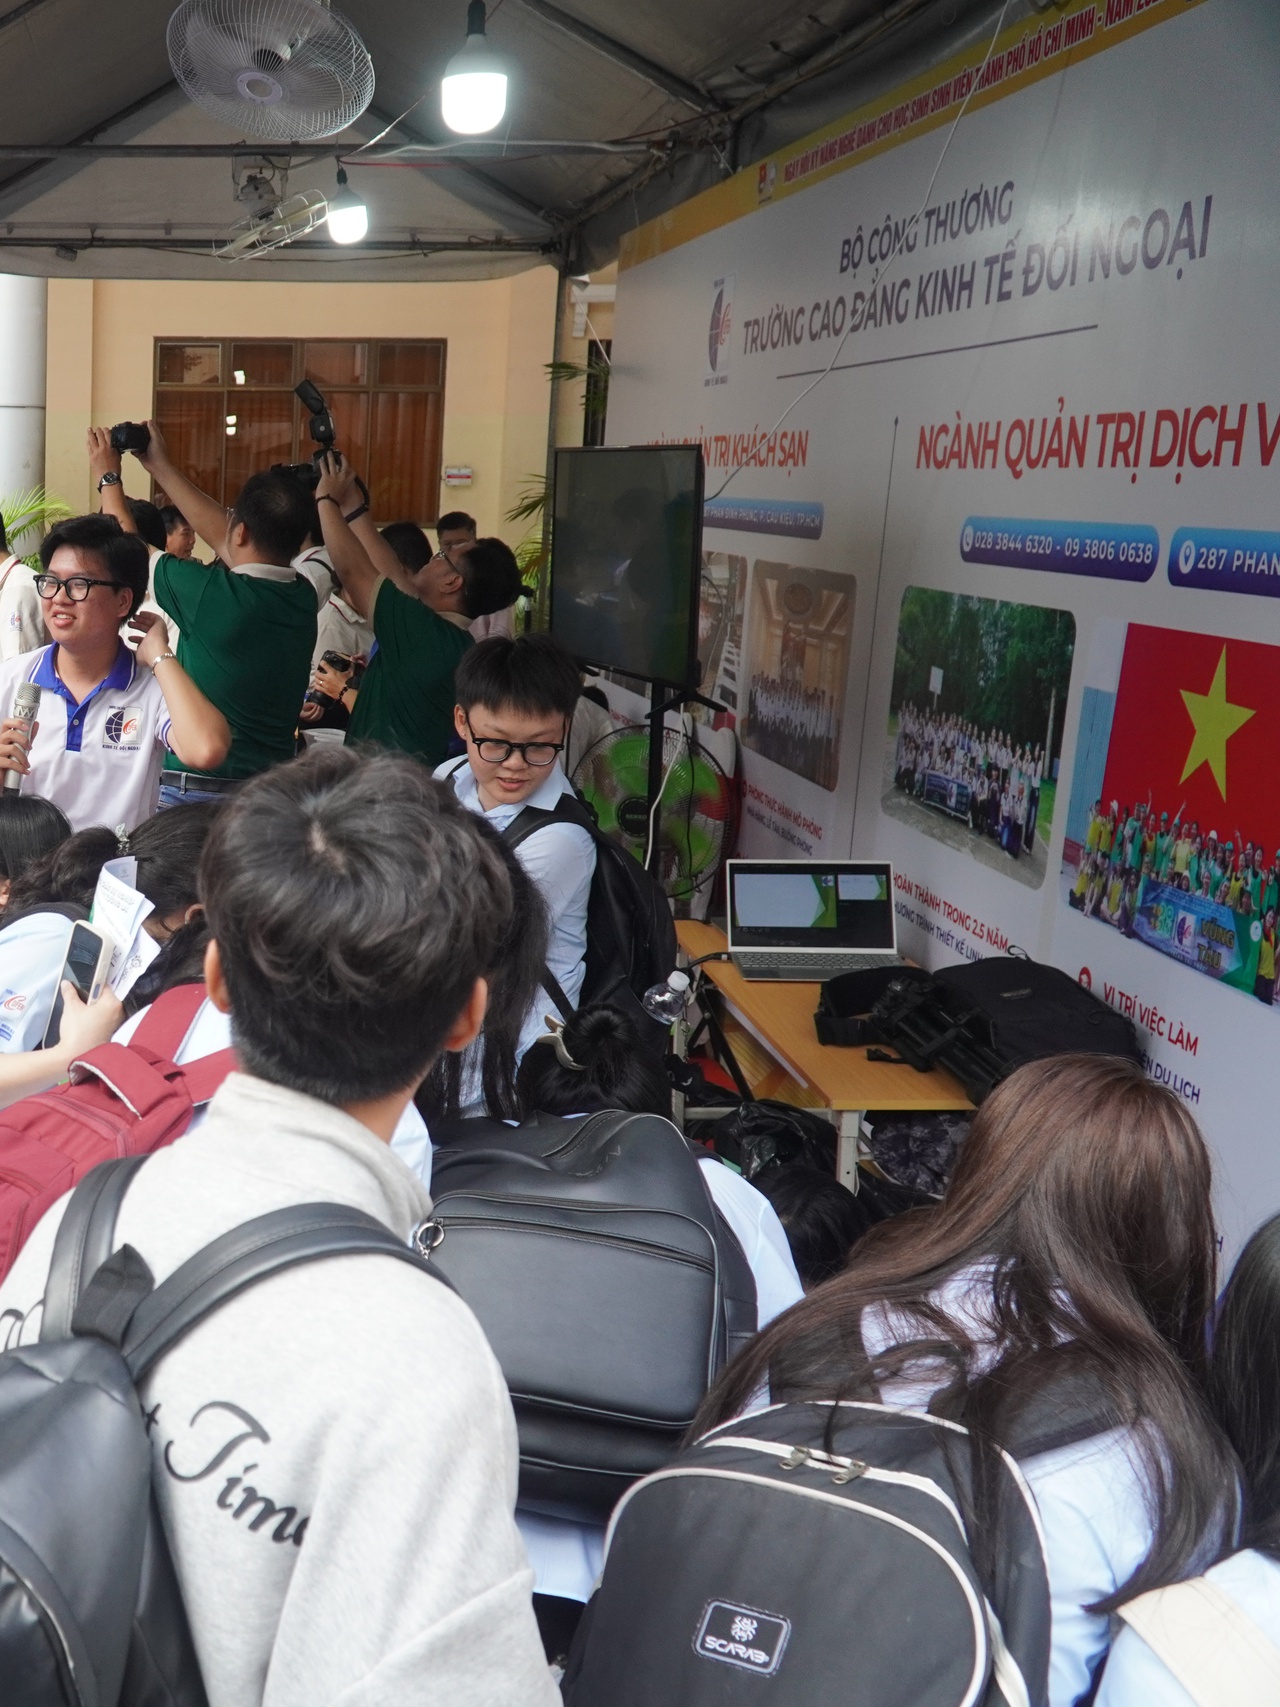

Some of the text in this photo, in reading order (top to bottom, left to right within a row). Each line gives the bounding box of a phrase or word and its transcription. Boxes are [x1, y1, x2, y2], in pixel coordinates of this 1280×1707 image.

[1044, 15, 1064, 57] CHÍ
[1064, 7, 1096, 47] MINH
[840, 180, 1014, 278] BỘ CÔNG THƯƠNG
[743, 195, 1213, 355] TRƯỜNG CAO ĐẲNG KINH TẾ ĐỐI NGOẠI
[714, 434, 731, 475] TRỊ
[732, 424, 777, 467] KHÁCH
[778, 430, 808, 477] SẠN
[916, 410, 1001, 469] NGÀNH
[1004, 396, 1090, 480] QUẢN
[1096, 410, 1146, 484] TRỊ
[1150, 403, 1248, 484] DỊCH
[975, 531, 1152, 564] 028 3844 6320 09 3806 0638
[1198, 547, 1280, 576] 287 PHAN
[895, 901, 914, 923] HƯƠNG
[916, 913, 934, 934] TRÌNH
[936, 926, 955, 948] THIẾT
[956, 938, 966, 955] KẾ
[915, 884, 940, 912] THÀNH
[943, 900, 970, 930] TRONG
[972, 919, 984, 939] 2.5
[986, 927, 1008, 954] NĂM
[1119, 992, 1138, 1019] TRÍ
[1140, 1003, 1166, 1036] VIỆC
[1168, 1021, 1198, 1056] LÀM
[1154, 1063, 1171, 1085] DU
